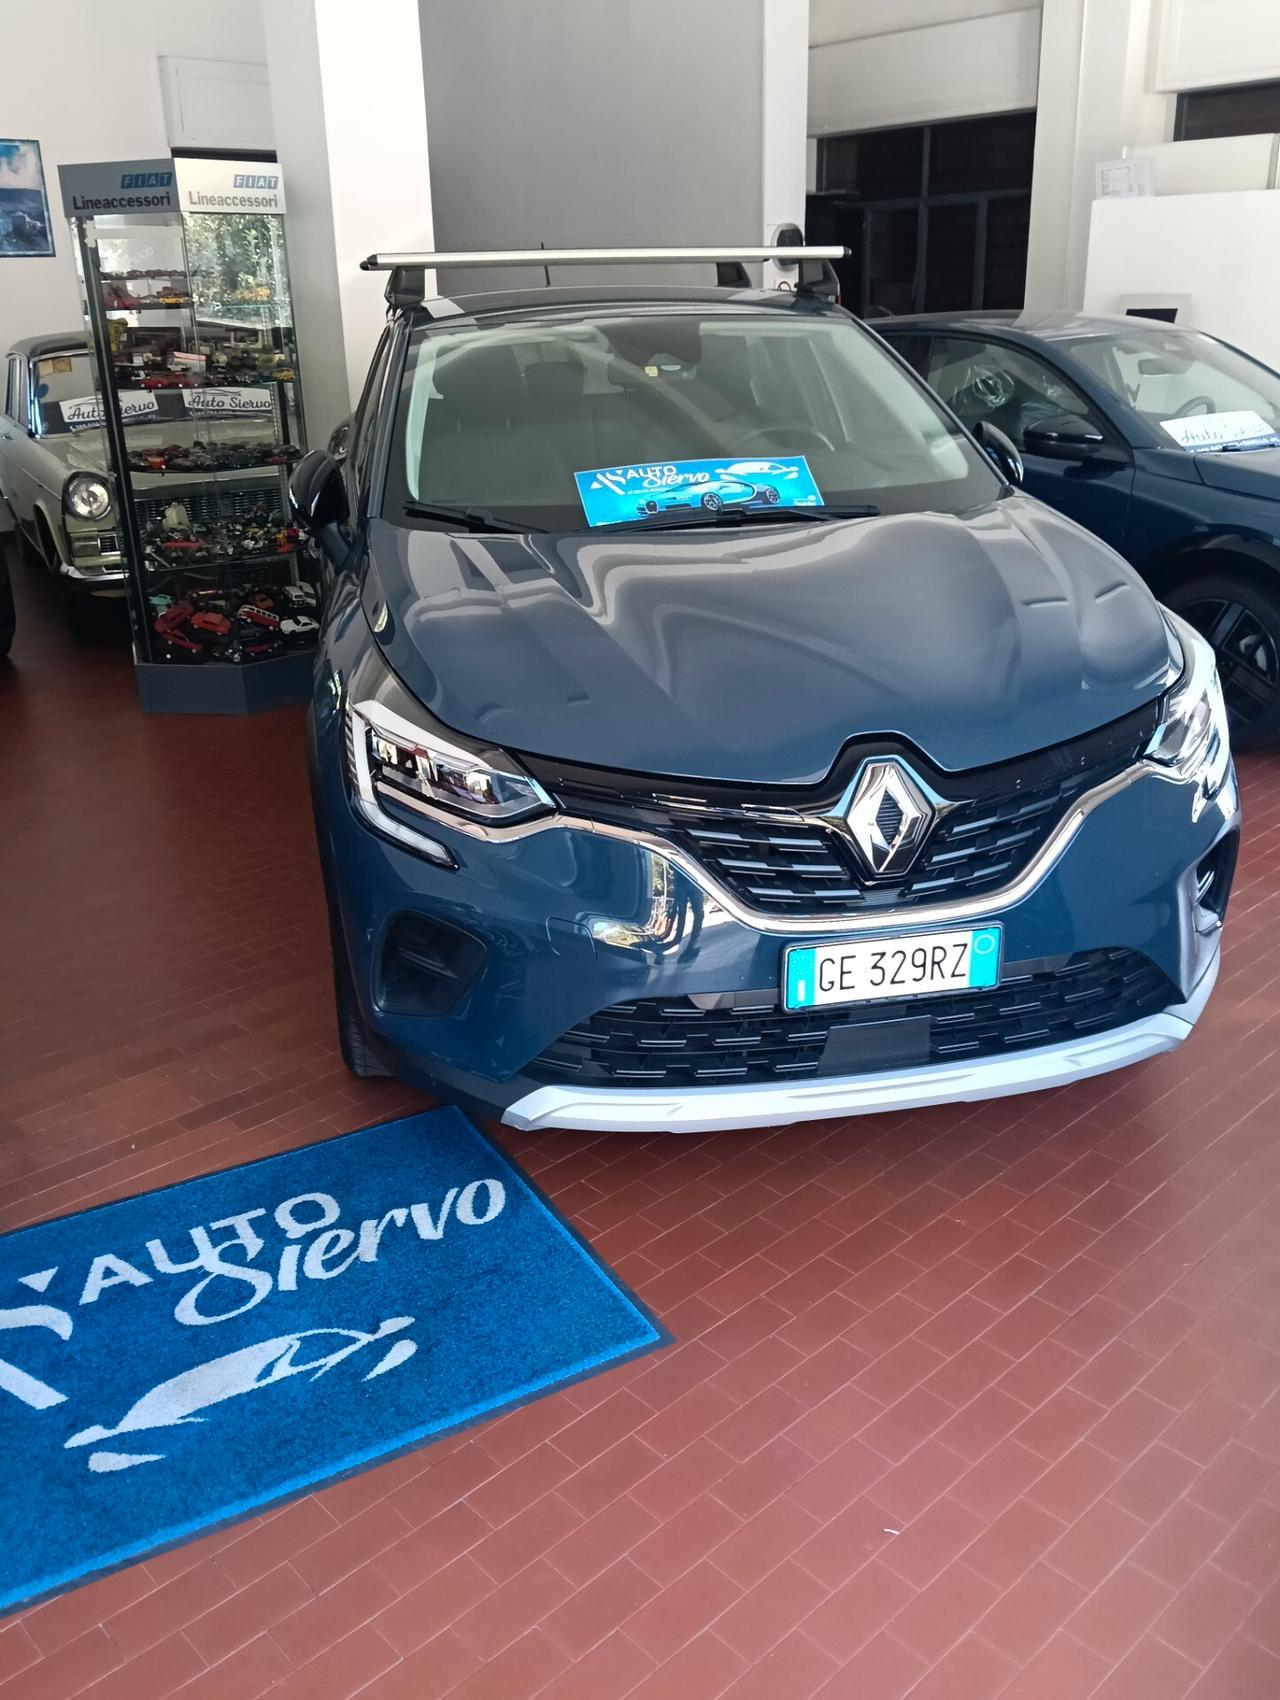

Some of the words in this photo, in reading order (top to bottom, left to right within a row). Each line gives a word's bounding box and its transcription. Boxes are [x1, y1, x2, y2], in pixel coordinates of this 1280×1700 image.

[122, 172, 172, 188] FIAT
[234, 175, 278, 189] FIAT
[72, 191, 171, 210] Lineaccessori
[188, 190, 278, 208] Lineaccessori
[119, 401, 155, 415] iervo
[188, 395, 225, 408] Auto
[229, 396, 271, 409] Siervo
[626, 465, 677, 480] AUTO
[642, 471, 710, 488] Siervo
[818, 955, 857, 992] GE
[869, 942, 968, 987] 329RZ
[78, 1192, 341, 1305] AUTO
[174, 1178, 506, 1326] Siervo
